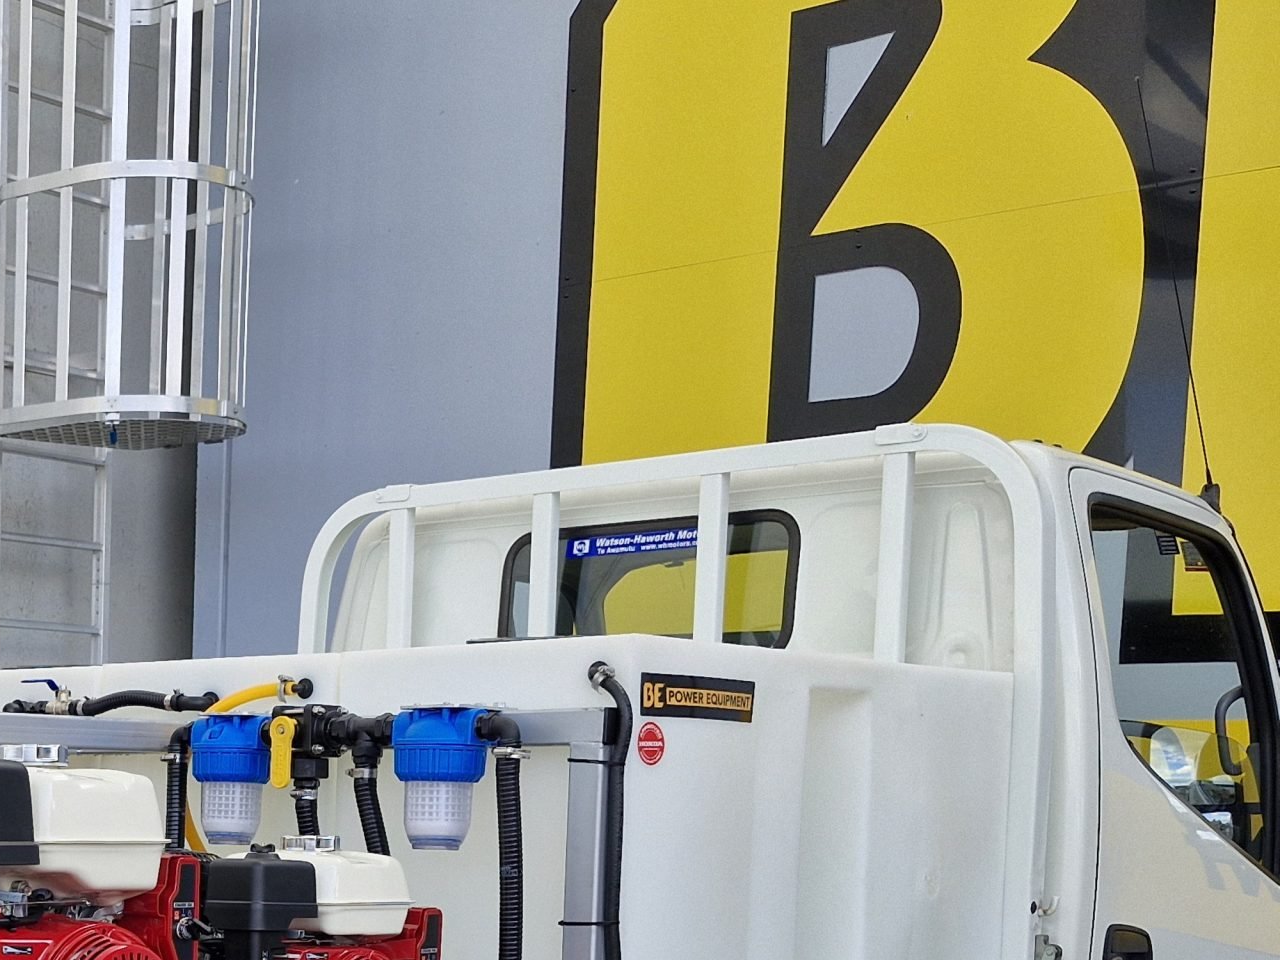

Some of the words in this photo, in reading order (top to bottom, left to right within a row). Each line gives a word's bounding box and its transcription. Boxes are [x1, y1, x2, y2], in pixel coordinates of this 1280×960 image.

[595, 531, 675, 548] Watson-Haworth
[597, 547, 606, 555] Te
[606, 545, 636, 555] Awamutu
[642, 682, 665, 708] BE
[668, 690, 704, 705] POWER
[706, 692, 751, 709] EQUIPMENT
